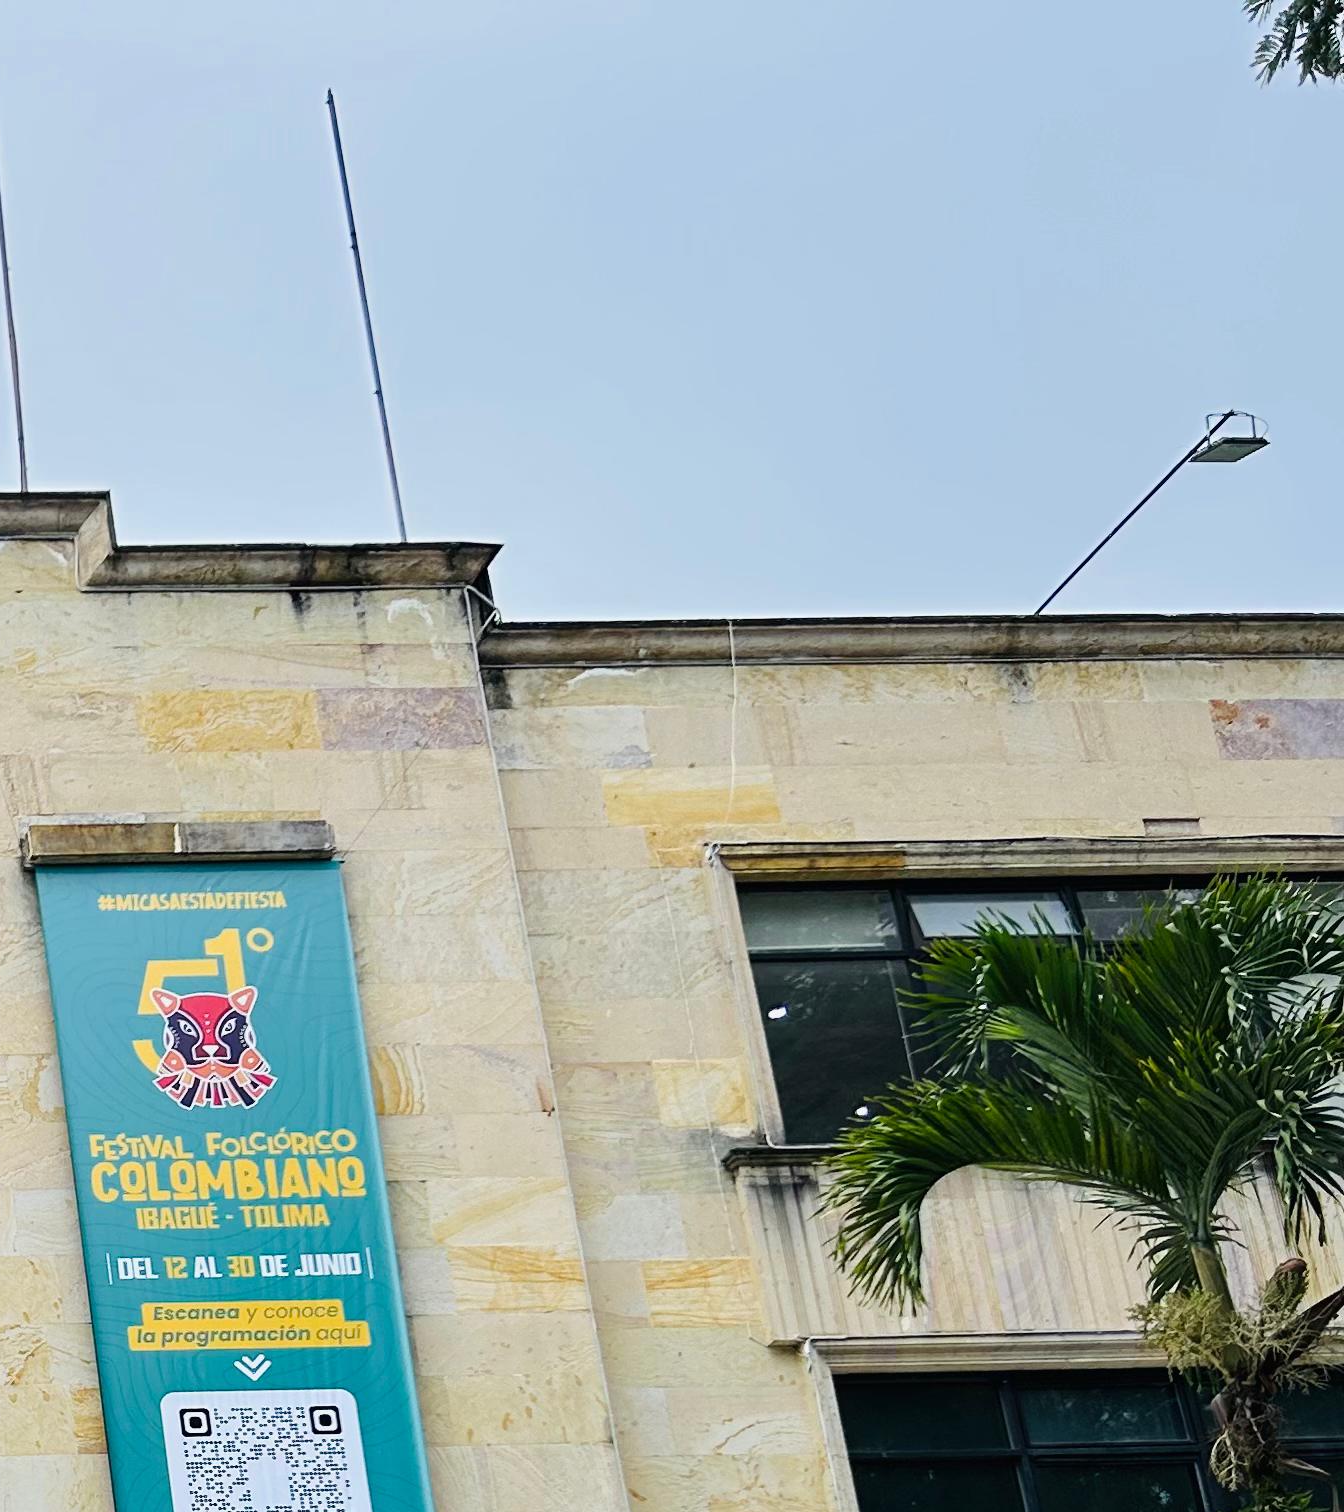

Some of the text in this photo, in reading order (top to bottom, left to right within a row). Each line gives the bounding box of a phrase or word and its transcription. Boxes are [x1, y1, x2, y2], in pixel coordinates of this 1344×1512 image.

[89, 1127, 358, 1161] FESTIVAL FOLCLÓRICO
[90, 1156, 367, 1203] COLOMBIANO
[135, 1203, 221, 1230] IBAGUÉ
[239, 1204, 331, 1228] TOLIMA
[117, 1253, 362, 1280] DEL 12 AL 30 DE JUNIO
[153, 1304, 339, 1321] Escanea y conoce
[136, 1323, 362, 1348] la programación aquí
